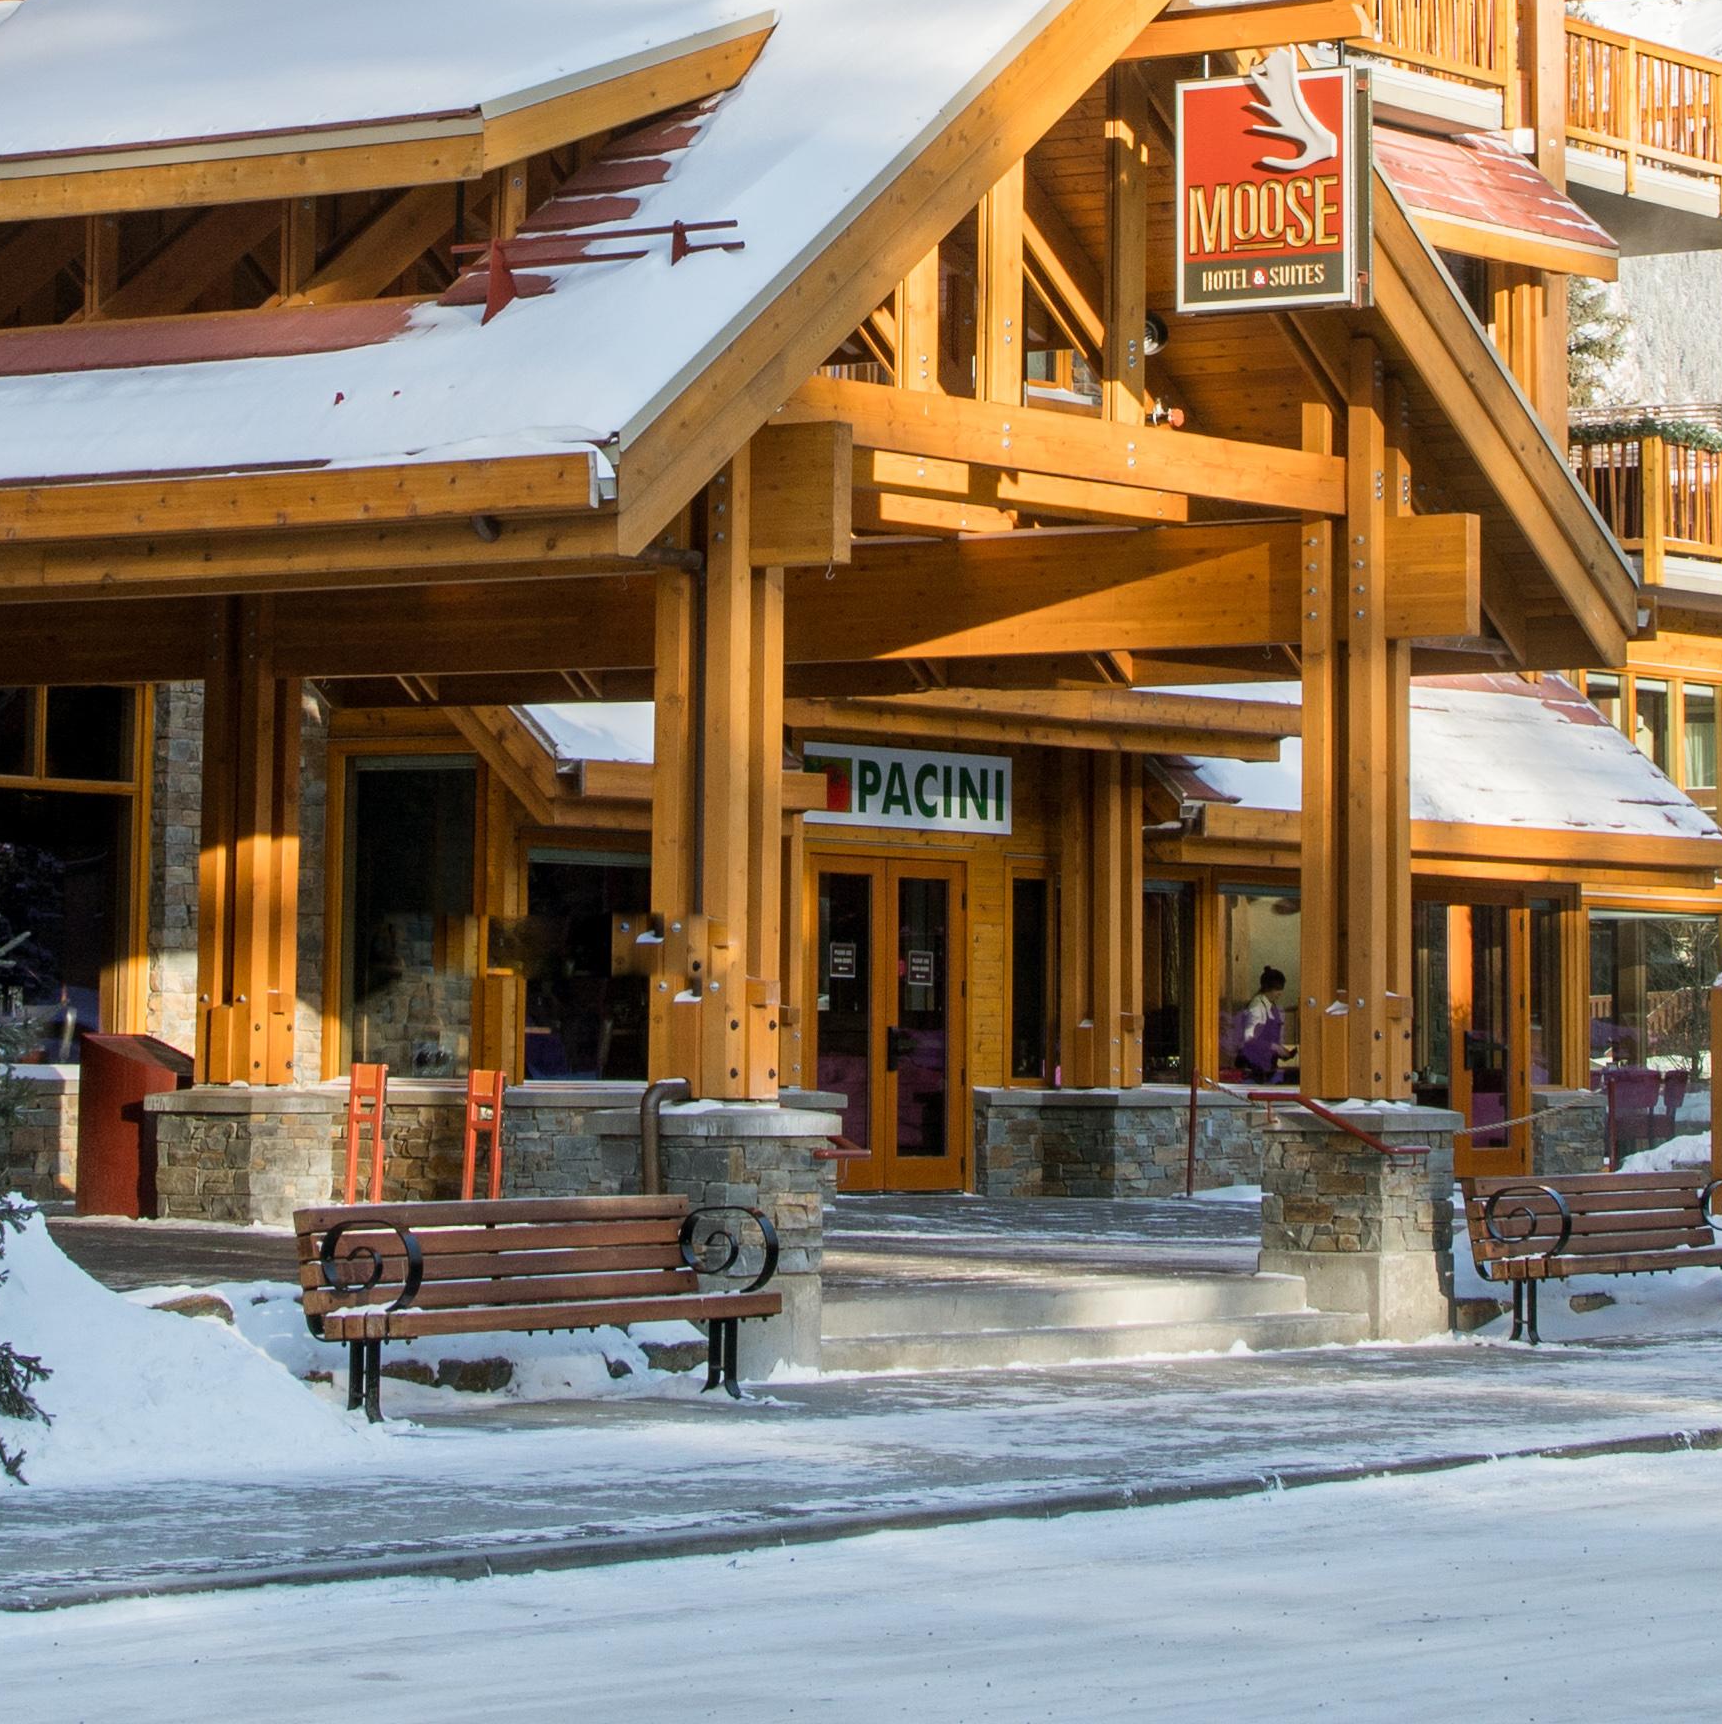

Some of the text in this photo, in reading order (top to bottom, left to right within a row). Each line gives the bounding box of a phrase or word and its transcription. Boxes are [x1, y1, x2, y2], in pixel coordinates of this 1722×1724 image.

[1188, 175, 1339, 255] MOOSE
[1202, 263, 1325, 292] HOTEL & SUITES
[858, 759, 1004, 821] PACINI
